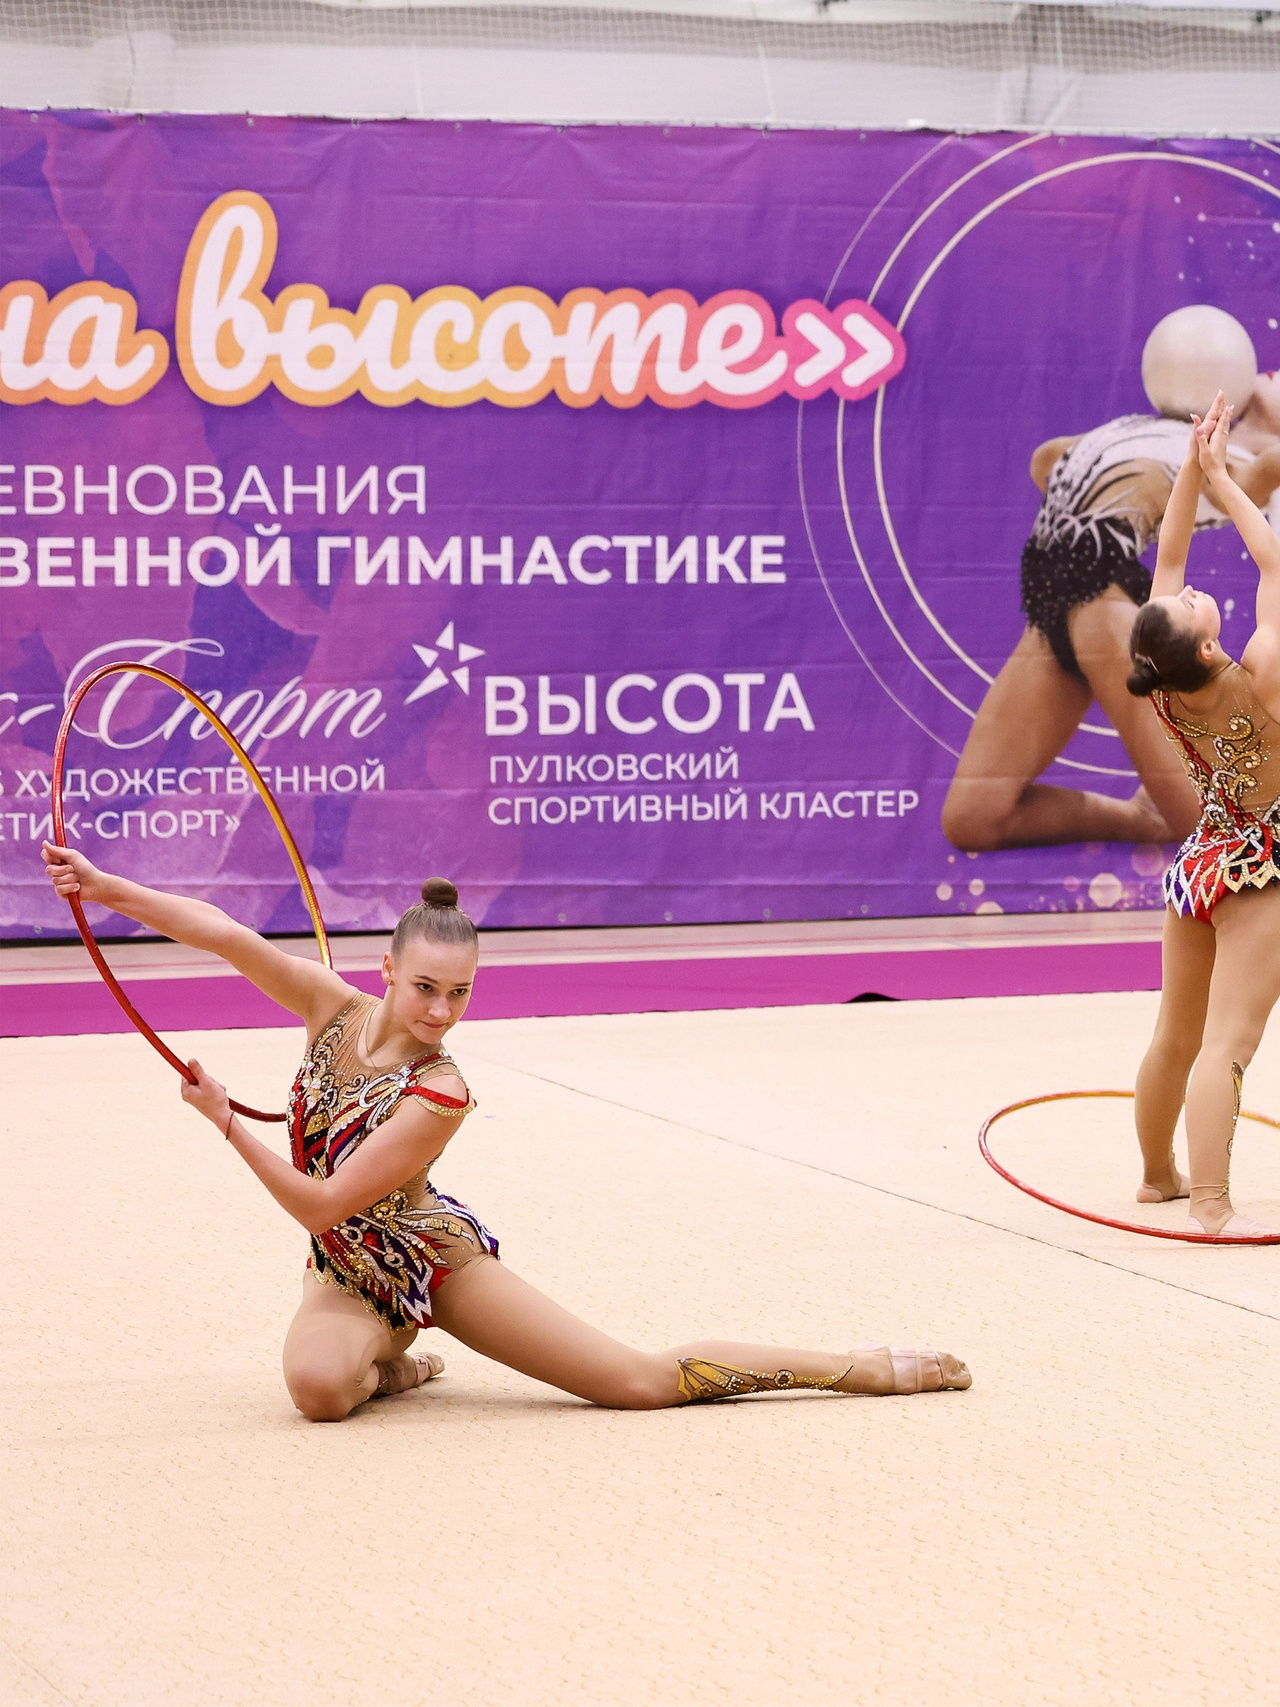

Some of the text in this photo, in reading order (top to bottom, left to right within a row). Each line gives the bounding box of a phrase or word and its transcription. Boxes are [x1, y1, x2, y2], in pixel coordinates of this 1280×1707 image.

[190, 203, 894, 396] высоте»
[317, 534, 787, 587] ГИМНАСТИКЕ
[0, 637, 388, 765] -Спорт
[485, 672, 815, 736] ВЫСОТА
[489, 745, 739, 784] ПУЛКОВСКИЙ
[0, 808, 240, 841] ТИК-СПОРТ»
[487, 787, 919, 826] СПОРТИВНЫЙ КЛАСТЕР
